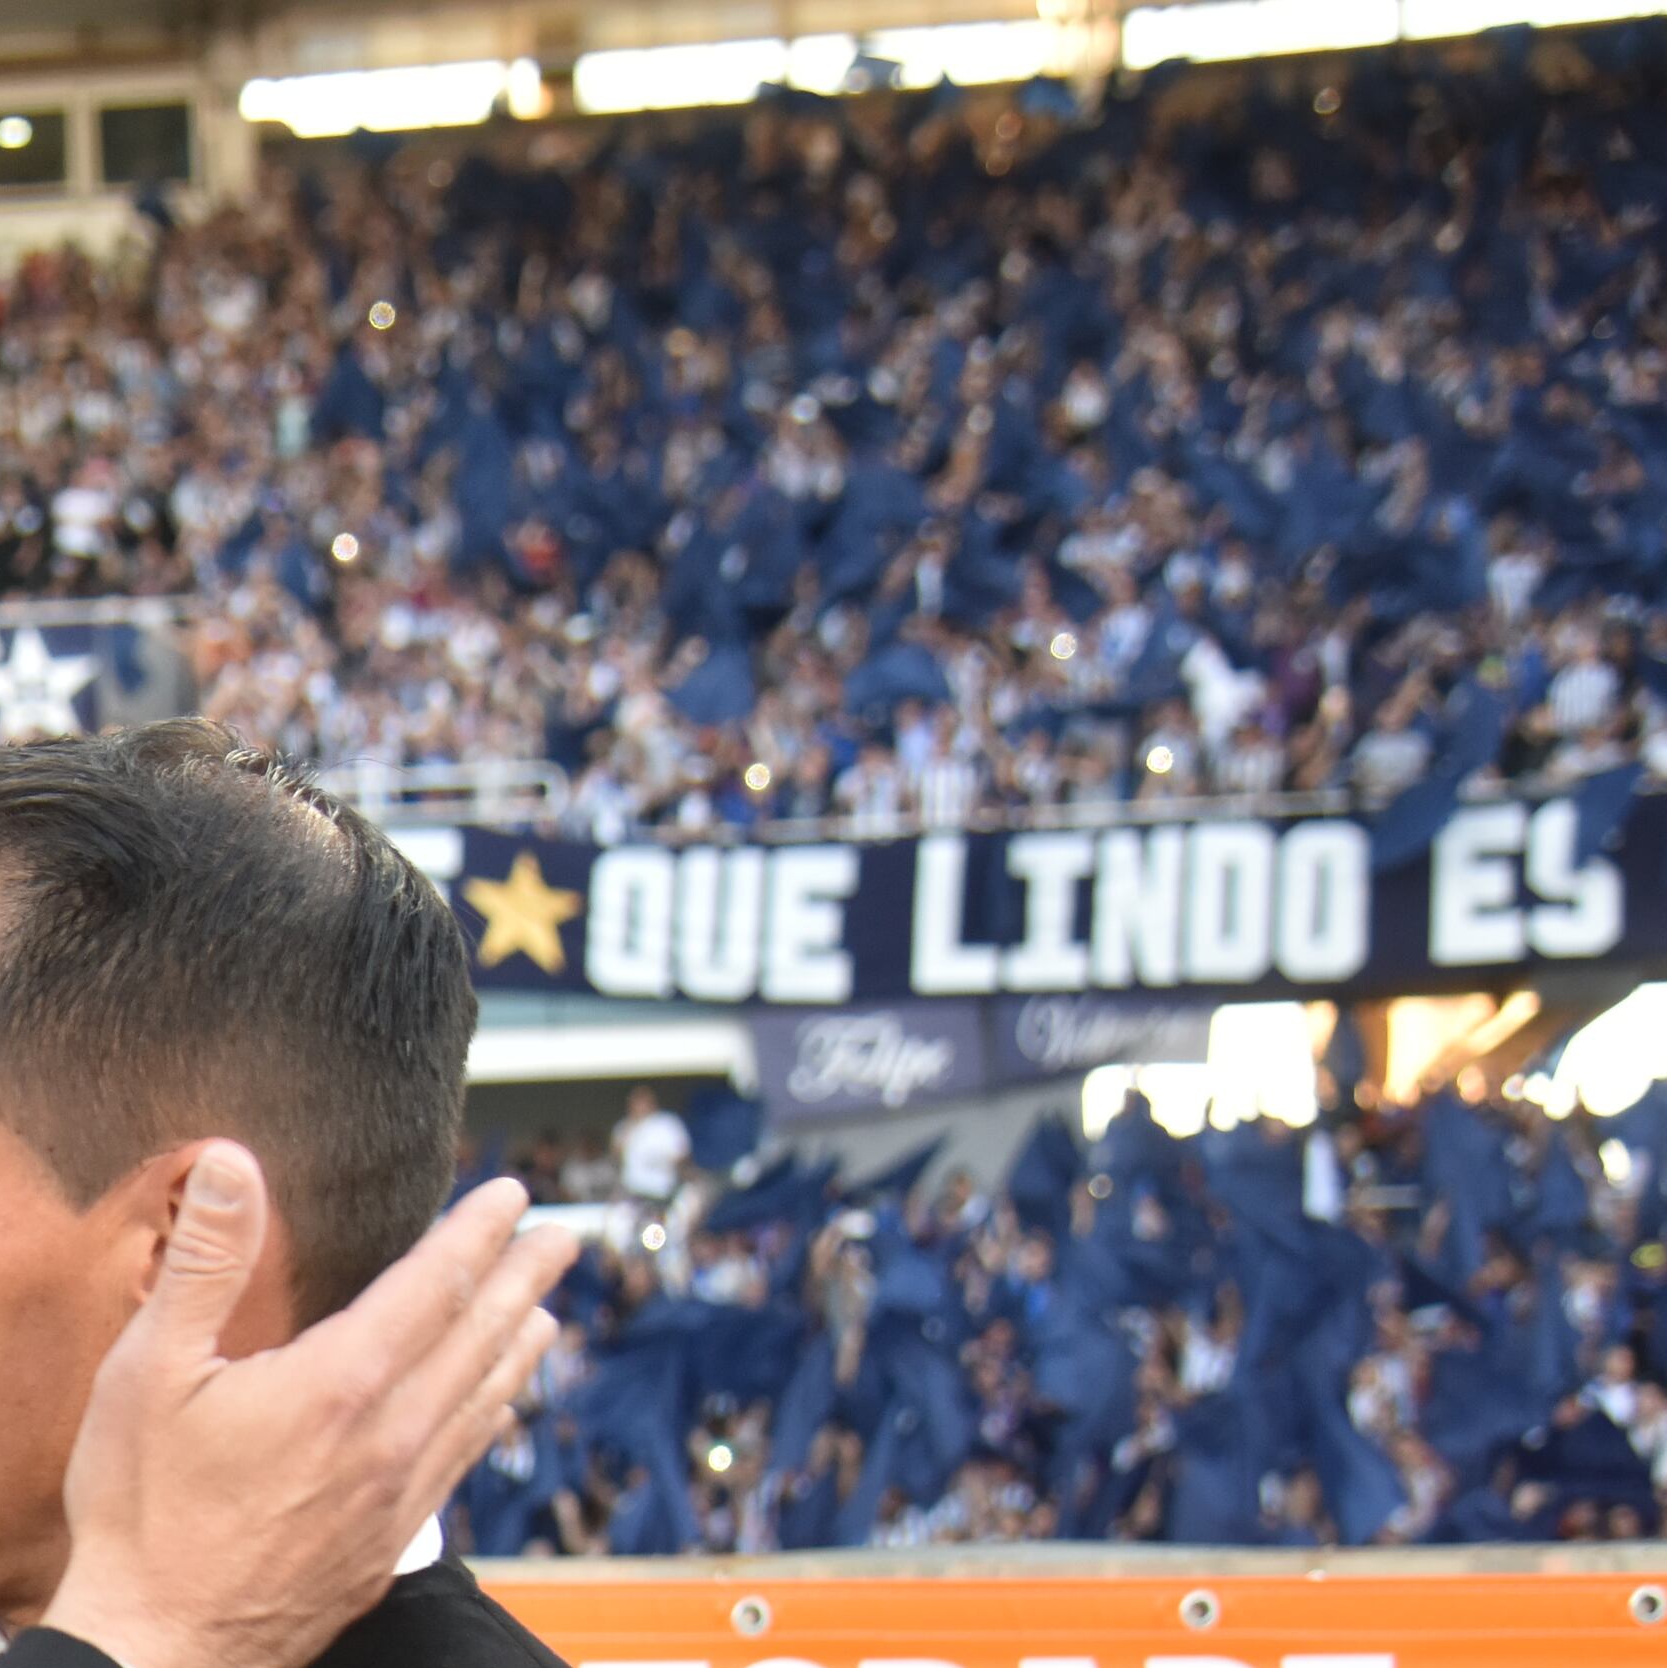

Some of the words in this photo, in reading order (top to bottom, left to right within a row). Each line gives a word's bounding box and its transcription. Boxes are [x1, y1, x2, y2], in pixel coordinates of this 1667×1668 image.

[585, 842, 860, 1002] QUE
[911, 819, 1369, 995] LINDO
[1427, 798, 1624, 966] ES
